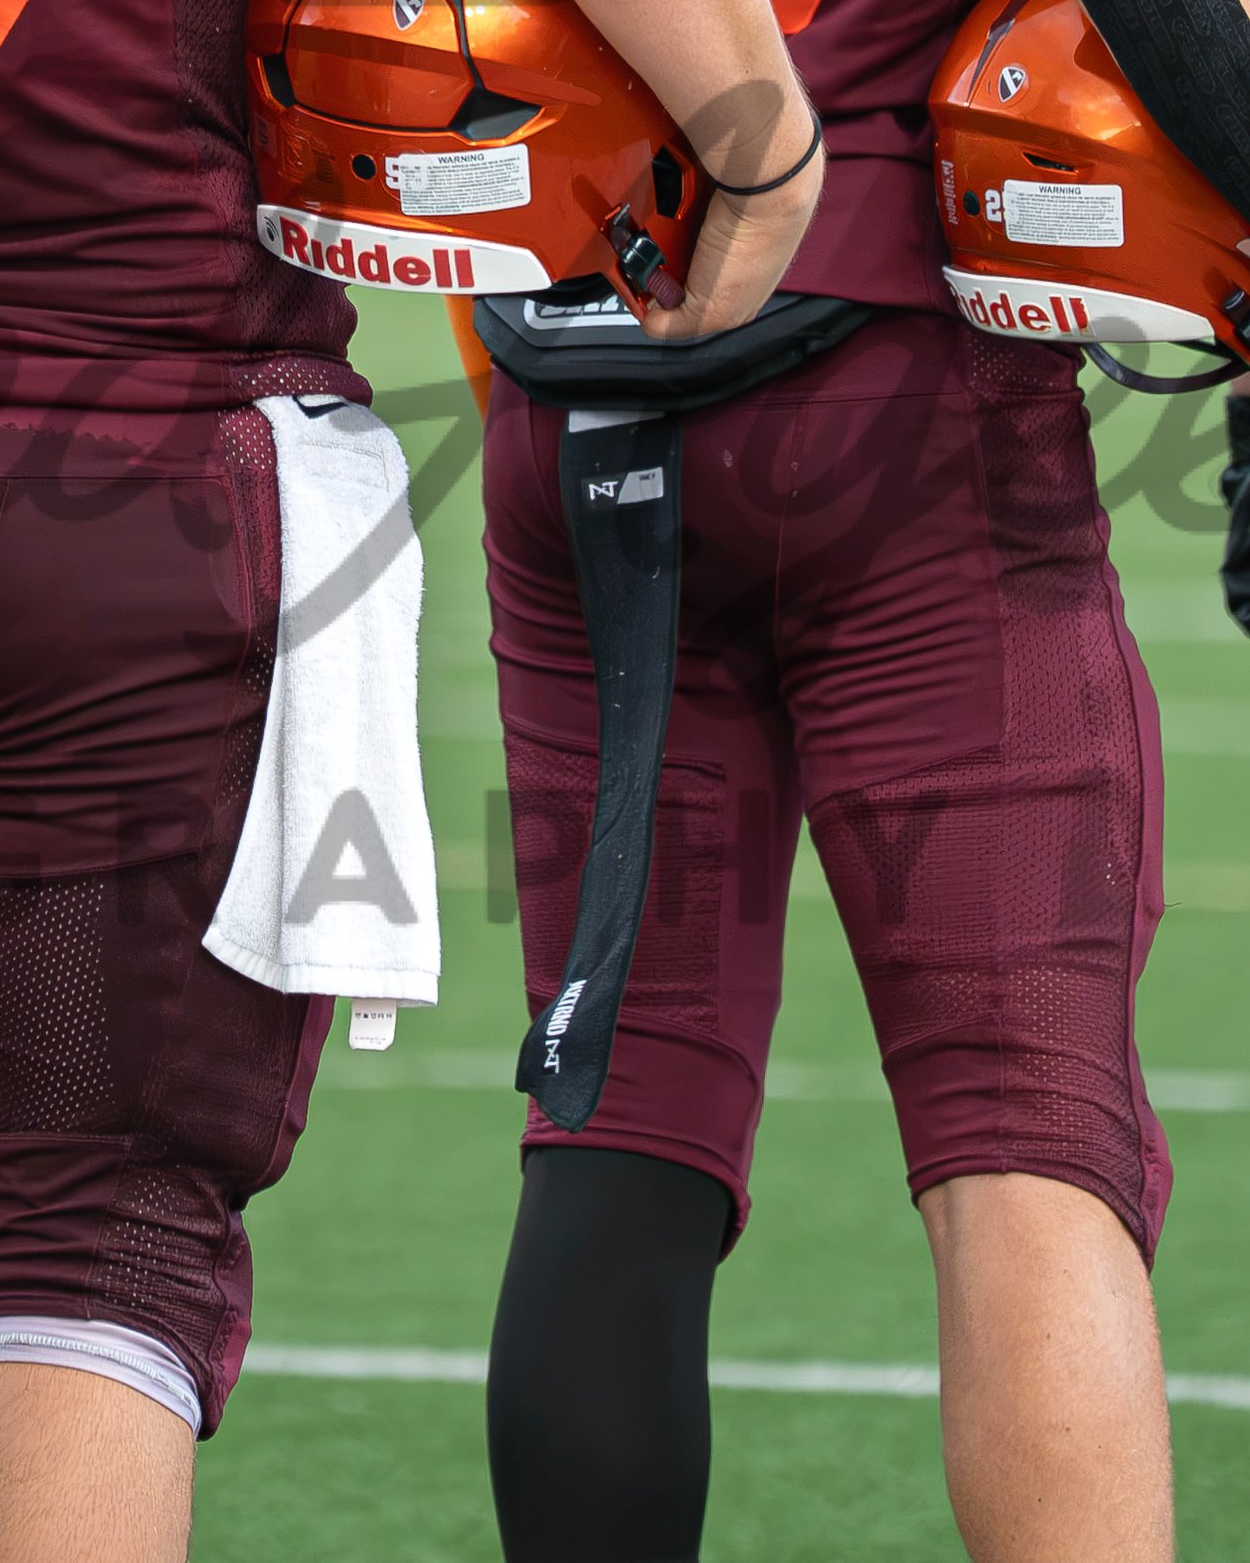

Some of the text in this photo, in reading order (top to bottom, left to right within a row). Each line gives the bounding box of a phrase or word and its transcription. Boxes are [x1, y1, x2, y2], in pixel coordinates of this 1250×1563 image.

[437, 153, 485, 165] WARNING
[1038, 185, 1082, 196] WARNING
[279, 213, 475, 288] Riddell
[952, 288, 1091, 334] iddell
